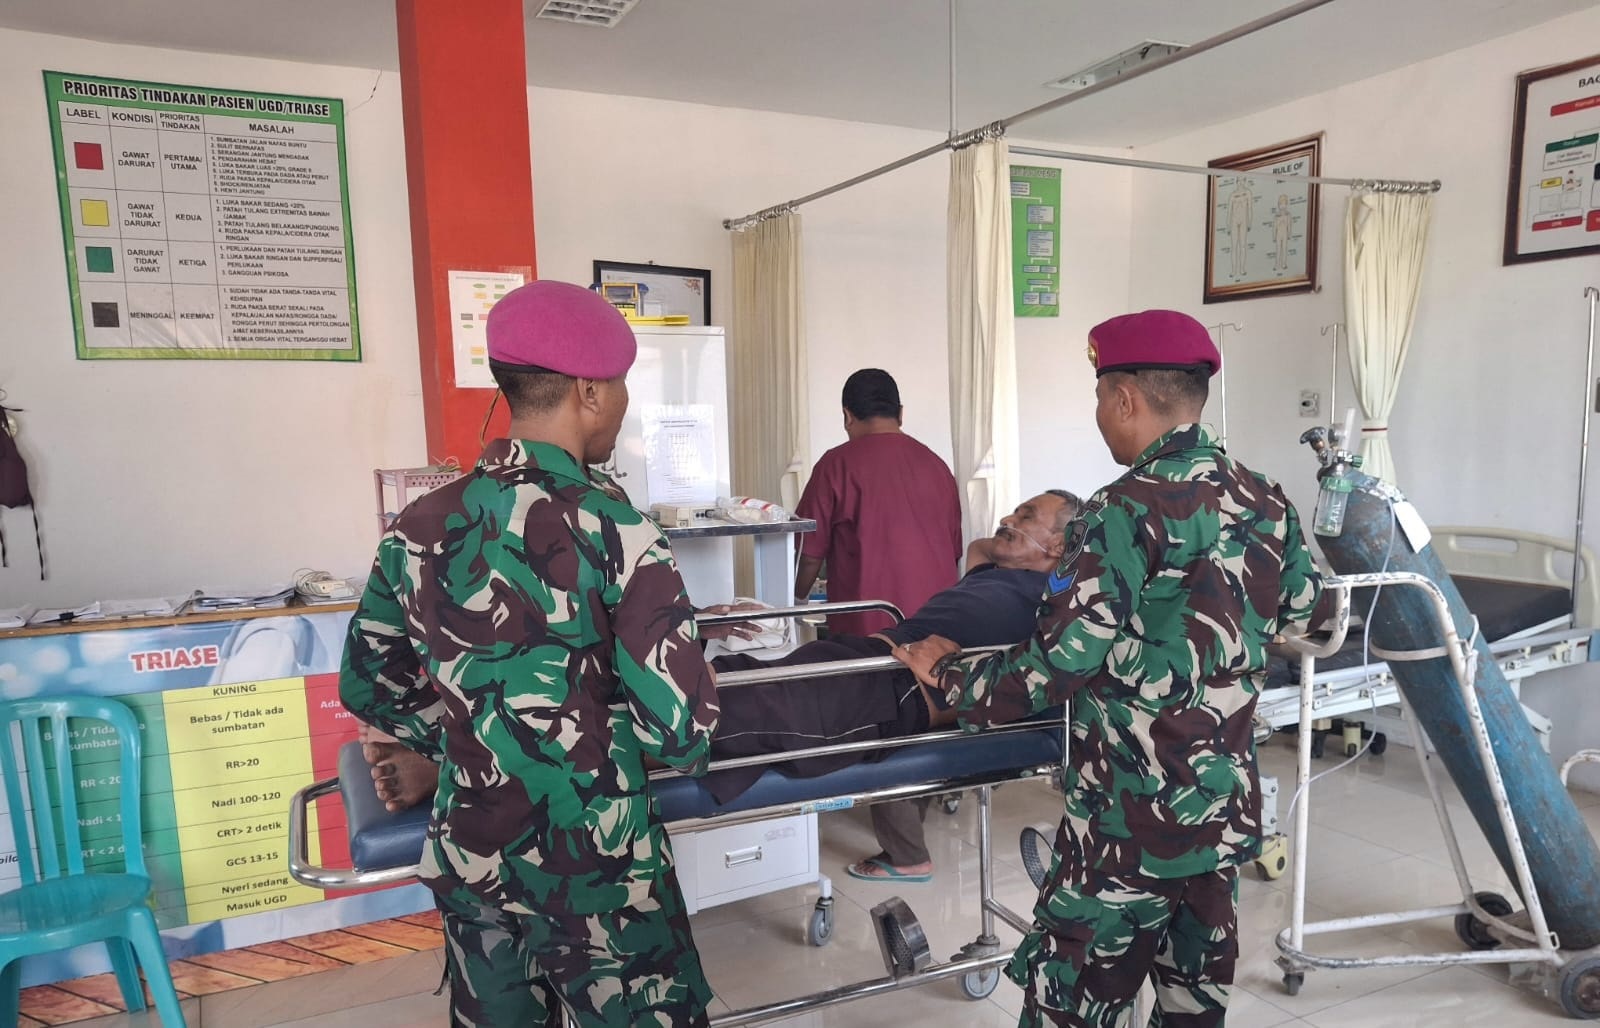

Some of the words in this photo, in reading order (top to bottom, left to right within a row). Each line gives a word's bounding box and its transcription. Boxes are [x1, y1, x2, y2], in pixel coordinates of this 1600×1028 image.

[64, 81, 137, 100] PRIORITAS
[141, 89, 206, 105] TINDAKAN
[211, 96, 254, 110] PASIEN
[259, 99, 329, 116] UGD/TRIASE
[67, 108, 101, 119] LABEL
[112, 112, 153, 123] KONDISI
[160, 113, 199, 122] PRIORITAS
[162, 122, 200, 131] TINDAKAN
[250, 124, 294, 134] MASALAH
[122, 151, 150, 159] GAWAT
[118, 160, 156, 168] DARURAT
[1272, 165, 1291, 175] RULE
[1293, 162, 1305, 171] OF
[131, 647, 218, 671] TRIASE
[213, 685, 257, 696] KUNING
[190, 713, 222, 724] Bebas
[226, 712, 230, 722] /
[233, 709, 262, 719] Tidak
[265, 707, 284, 715] ada
[91, 727, 115, 735] Tida
[212, 722, 265, 734] sumbatan
[70, 739, 120, 751] sumbata
[226, 758, 260, 770] RR>20
[81, 779, 96, 788] RR
[212, 798, 236, 808] Nadi
[240, 792, 281, 804] 100-120
[78, 816, 103, 826] Nadi
[217, 828, 243, 838] CRT>
[255, 822, 282, 832] detik
[226, 857, 247, 867] GCS
[251, 852, 279, 863] 13-15
[222, 884, 249, 894] Nyeri
[252, 878, 288, 889] sedang
[227, 900, 261, 912] Masuk
[264, 895, 287, 905] UGD
